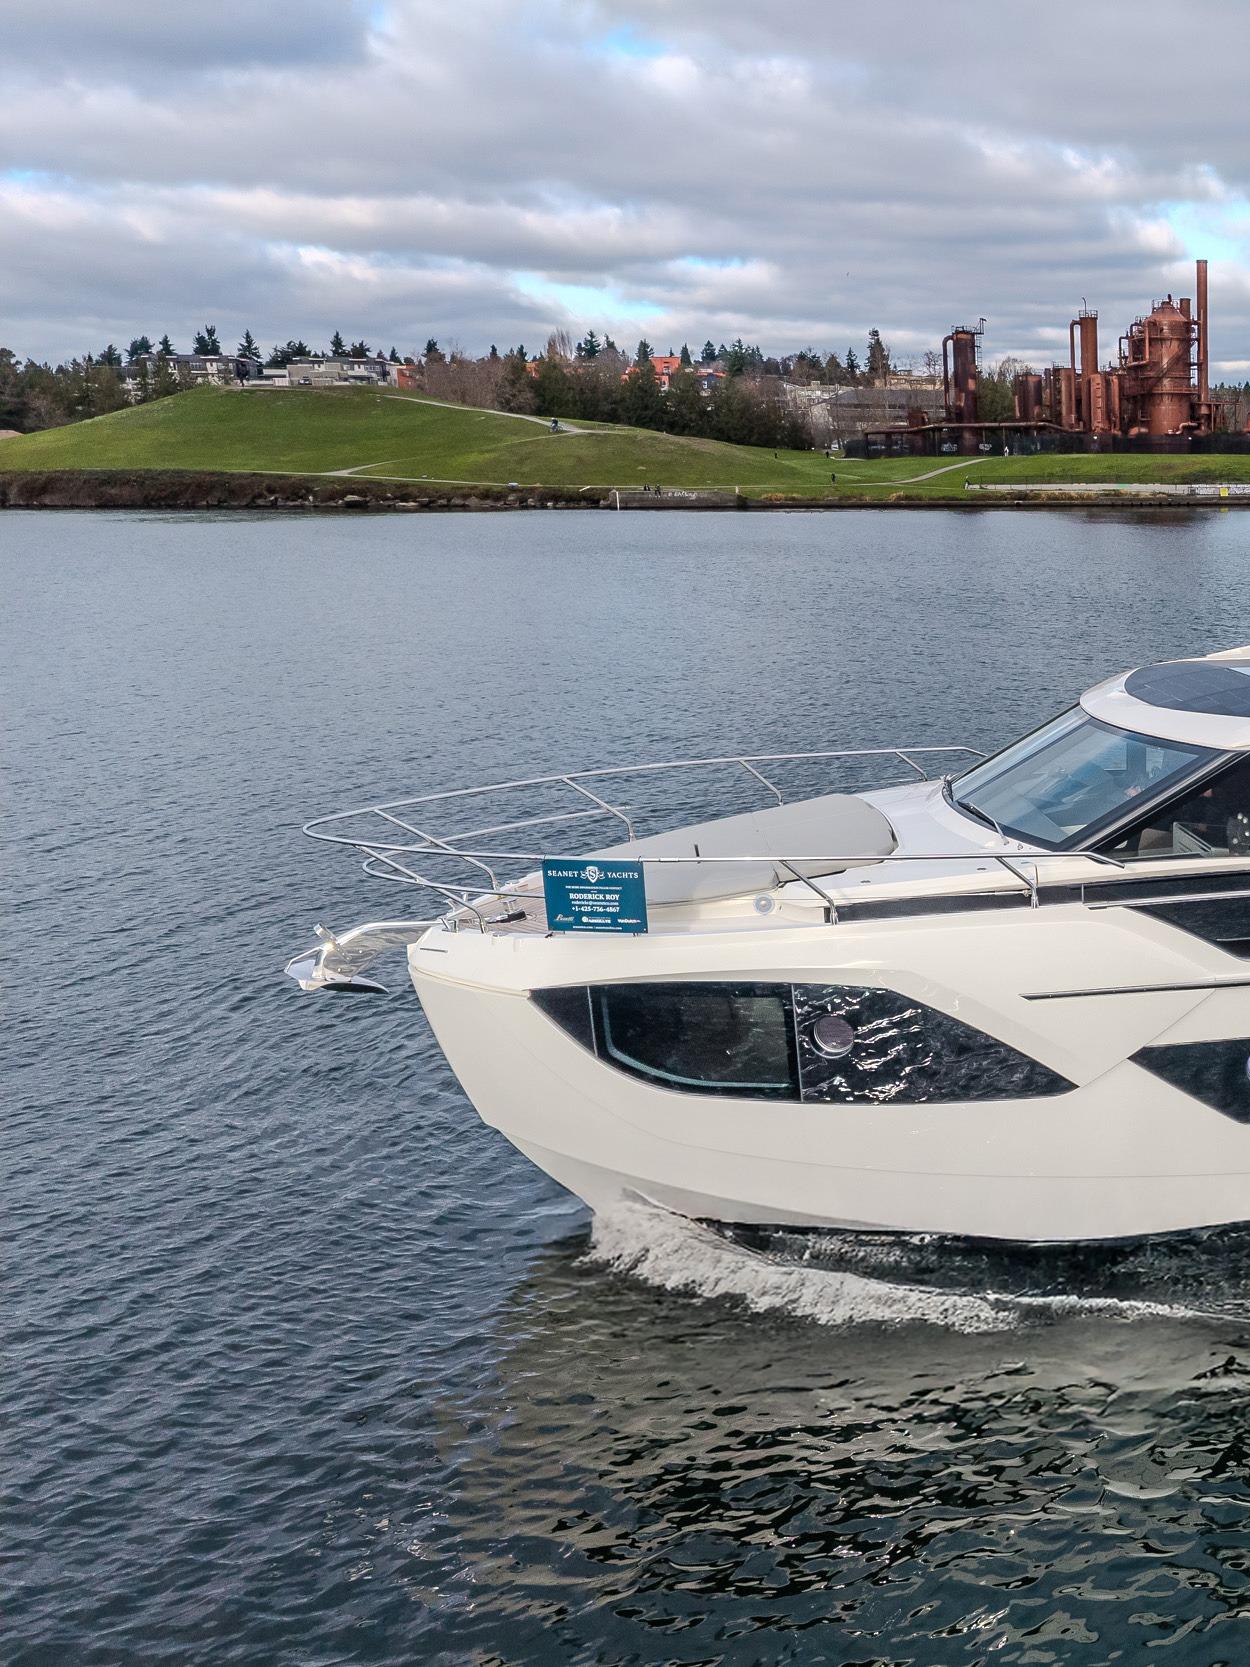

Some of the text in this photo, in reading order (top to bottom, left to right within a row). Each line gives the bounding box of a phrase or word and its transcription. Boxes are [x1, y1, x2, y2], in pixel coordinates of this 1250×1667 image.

[547, 870, 579, 878] SEANET
[607, 871, 639, 879] YACHTS
[605, 893, 620, 901] ROY
